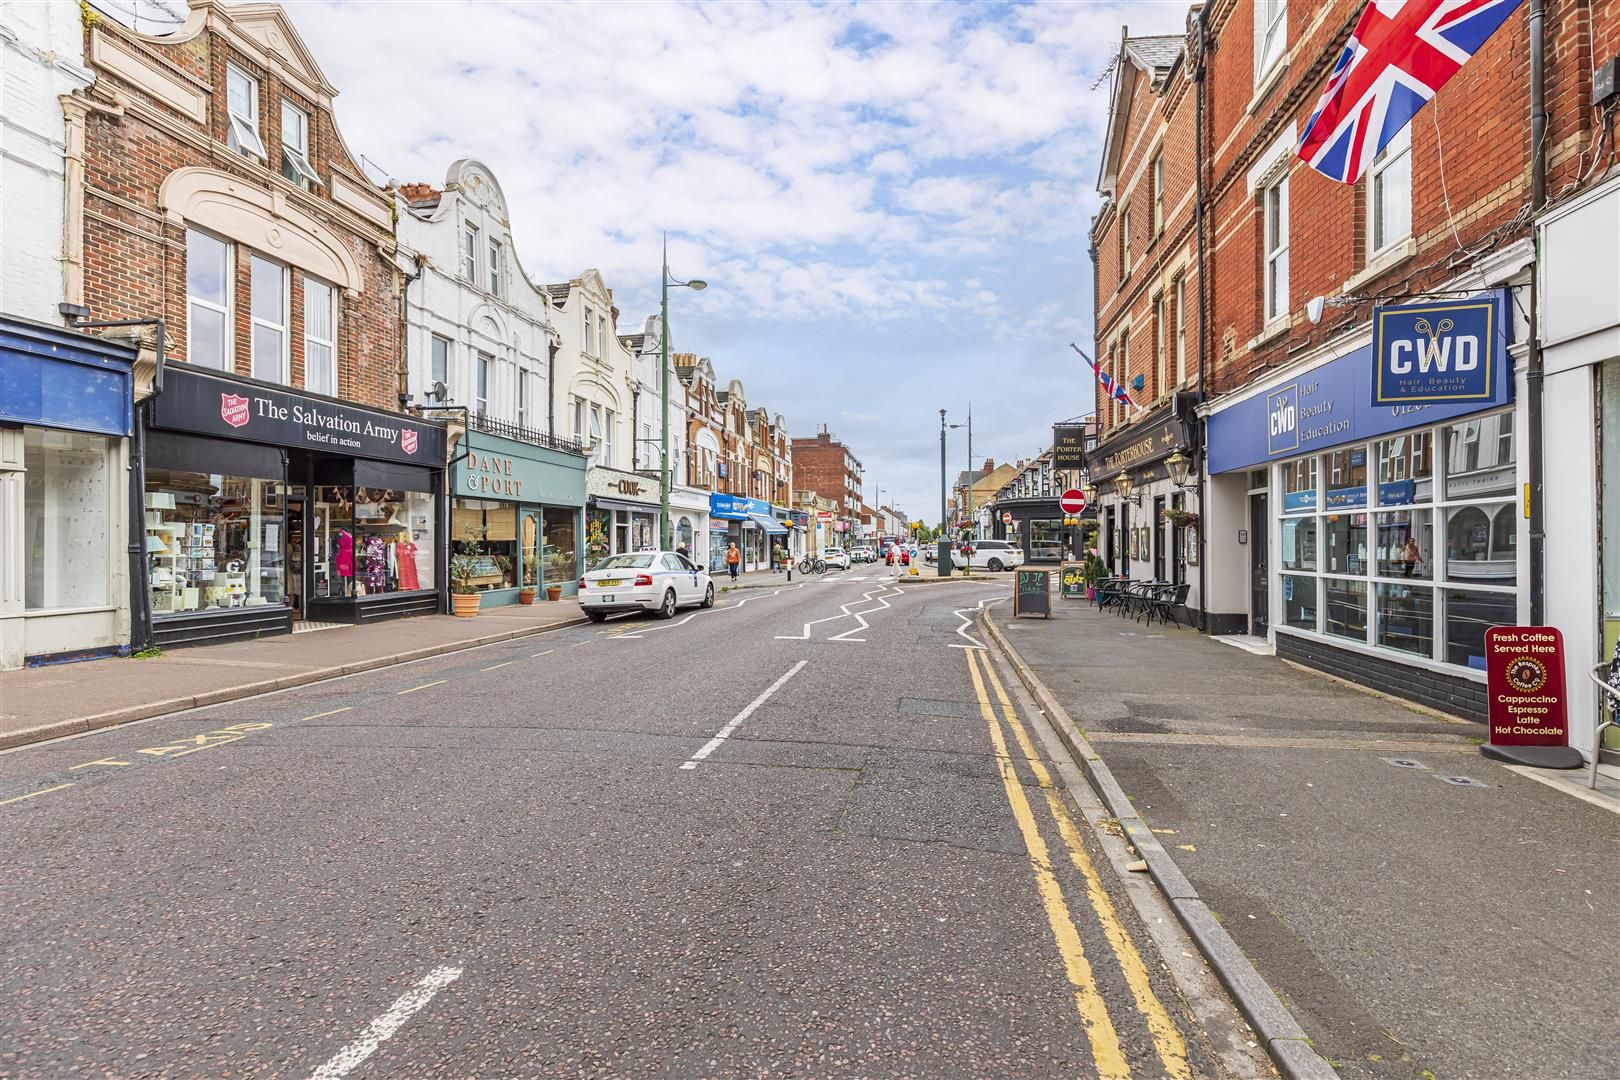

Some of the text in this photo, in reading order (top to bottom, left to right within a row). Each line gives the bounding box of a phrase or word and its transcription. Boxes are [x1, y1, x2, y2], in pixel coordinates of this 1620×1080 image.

[1390, 335, 1479, 374] CWD
[1429, 376, 1466, 385] Beauty
[1300, 381, 1320, 397] Hair
[1300, 400, 1334, 419] Beauty
[254, 397, 288, 420] The
[293, 405, 360, 433] Salvation
[363, 420, 399, 443] Army
[1270, 405, 1295, 436] CWD
[1301, 419, 1350, 442] Education
[306, 431, 361, 447] belief in action
[1105, 437, 1155, 470] THE PORTERHOUSE
[467, 453, 512, 476] DANE
[481, 476, 522, 497] PORT
[618, 480, 639, 497] COOK
[1493, 633, 1555, 642] Fresh Coffee
[1494, 644, 1556, 653] Served Here
[1510, 661, 1541, 675] The Bespoke
[1513, 678, 1532, 689] Coffee
[1498, 695, 1557, 704] Cappuccino
[1508, 705, 1548, 714] Espresso
[1517, 716, 1540, 724] Latte
[1495, 726, 1563, 735] Hot Chocolate
